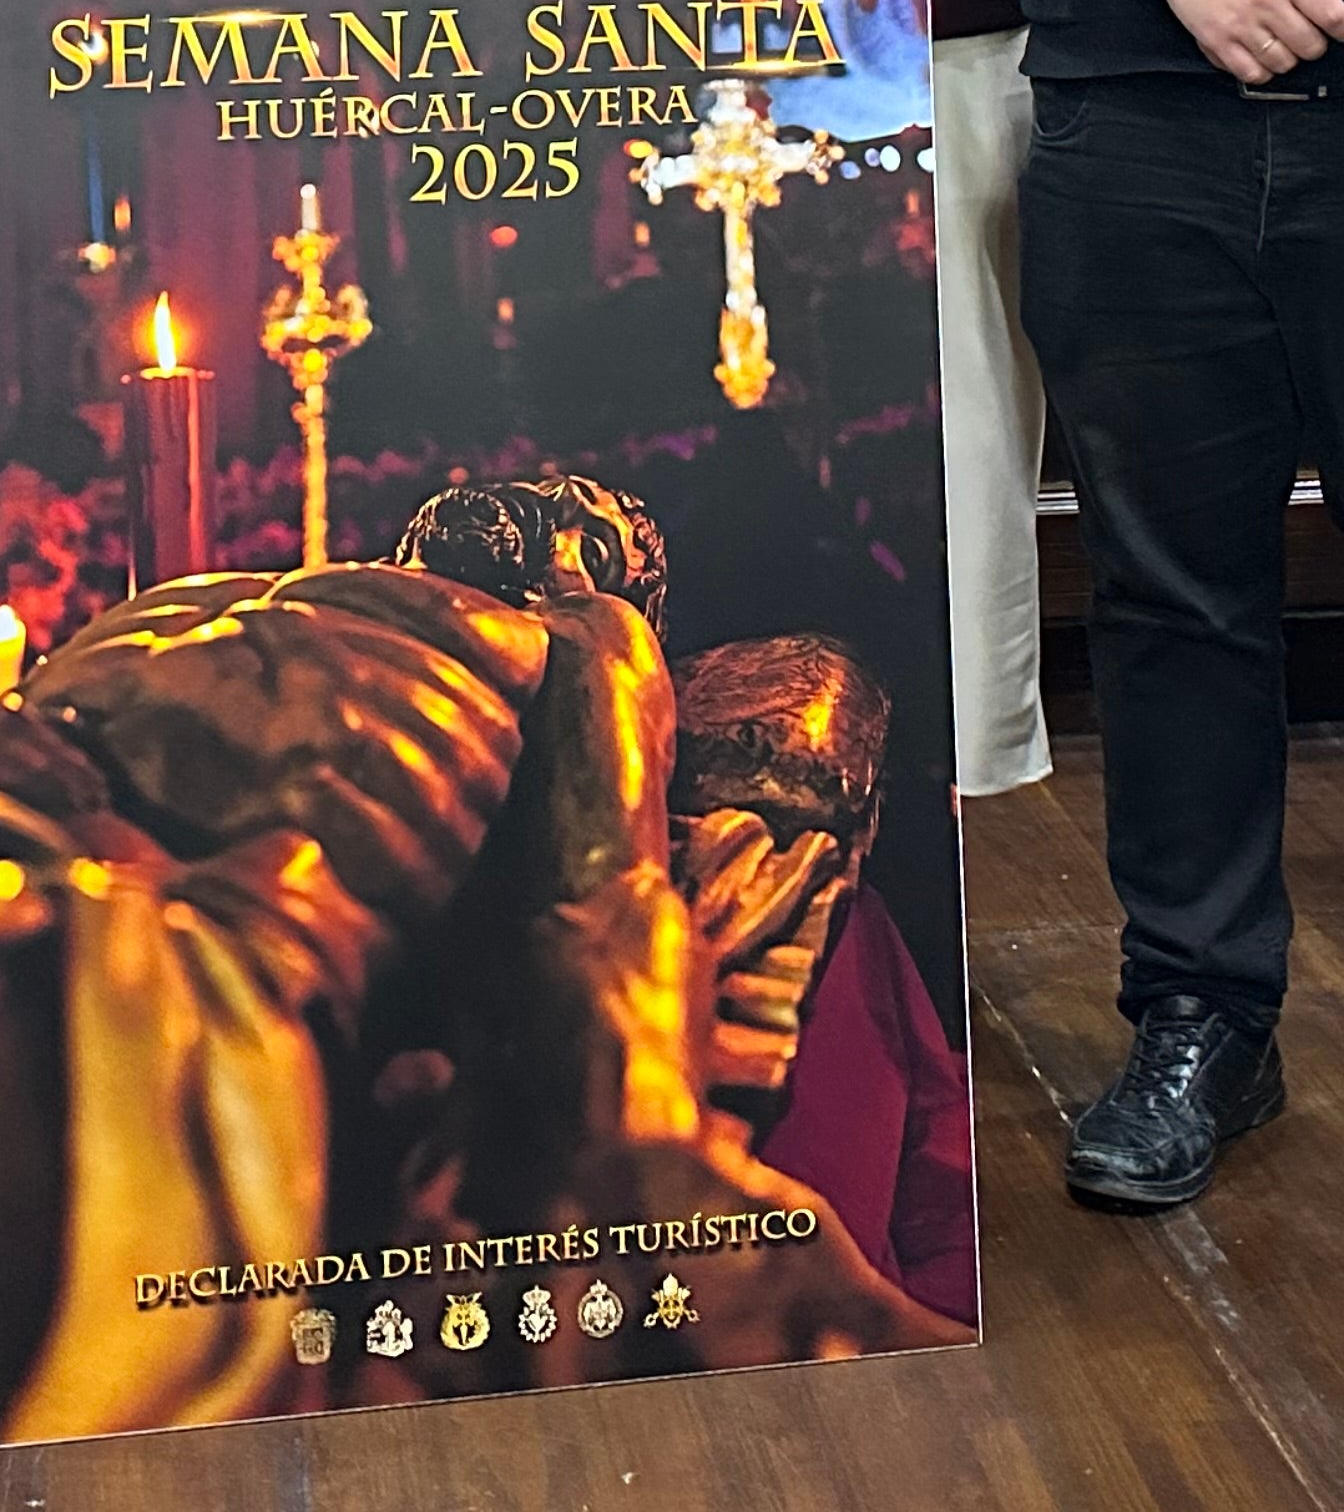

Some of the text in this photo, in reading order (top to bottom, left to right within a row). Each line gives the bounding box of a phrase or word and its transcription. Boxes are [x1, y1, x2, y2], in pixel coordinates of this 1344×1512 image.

[49, 7, 484, 99] SEMANA
[216, 84, 699, 141] HUÉRCAL-OVERA
[409, 137, 581, 205] 2025
[135, 1208, 817, 1305] DECLARADA DE INTERÉS TURÍSTICO
